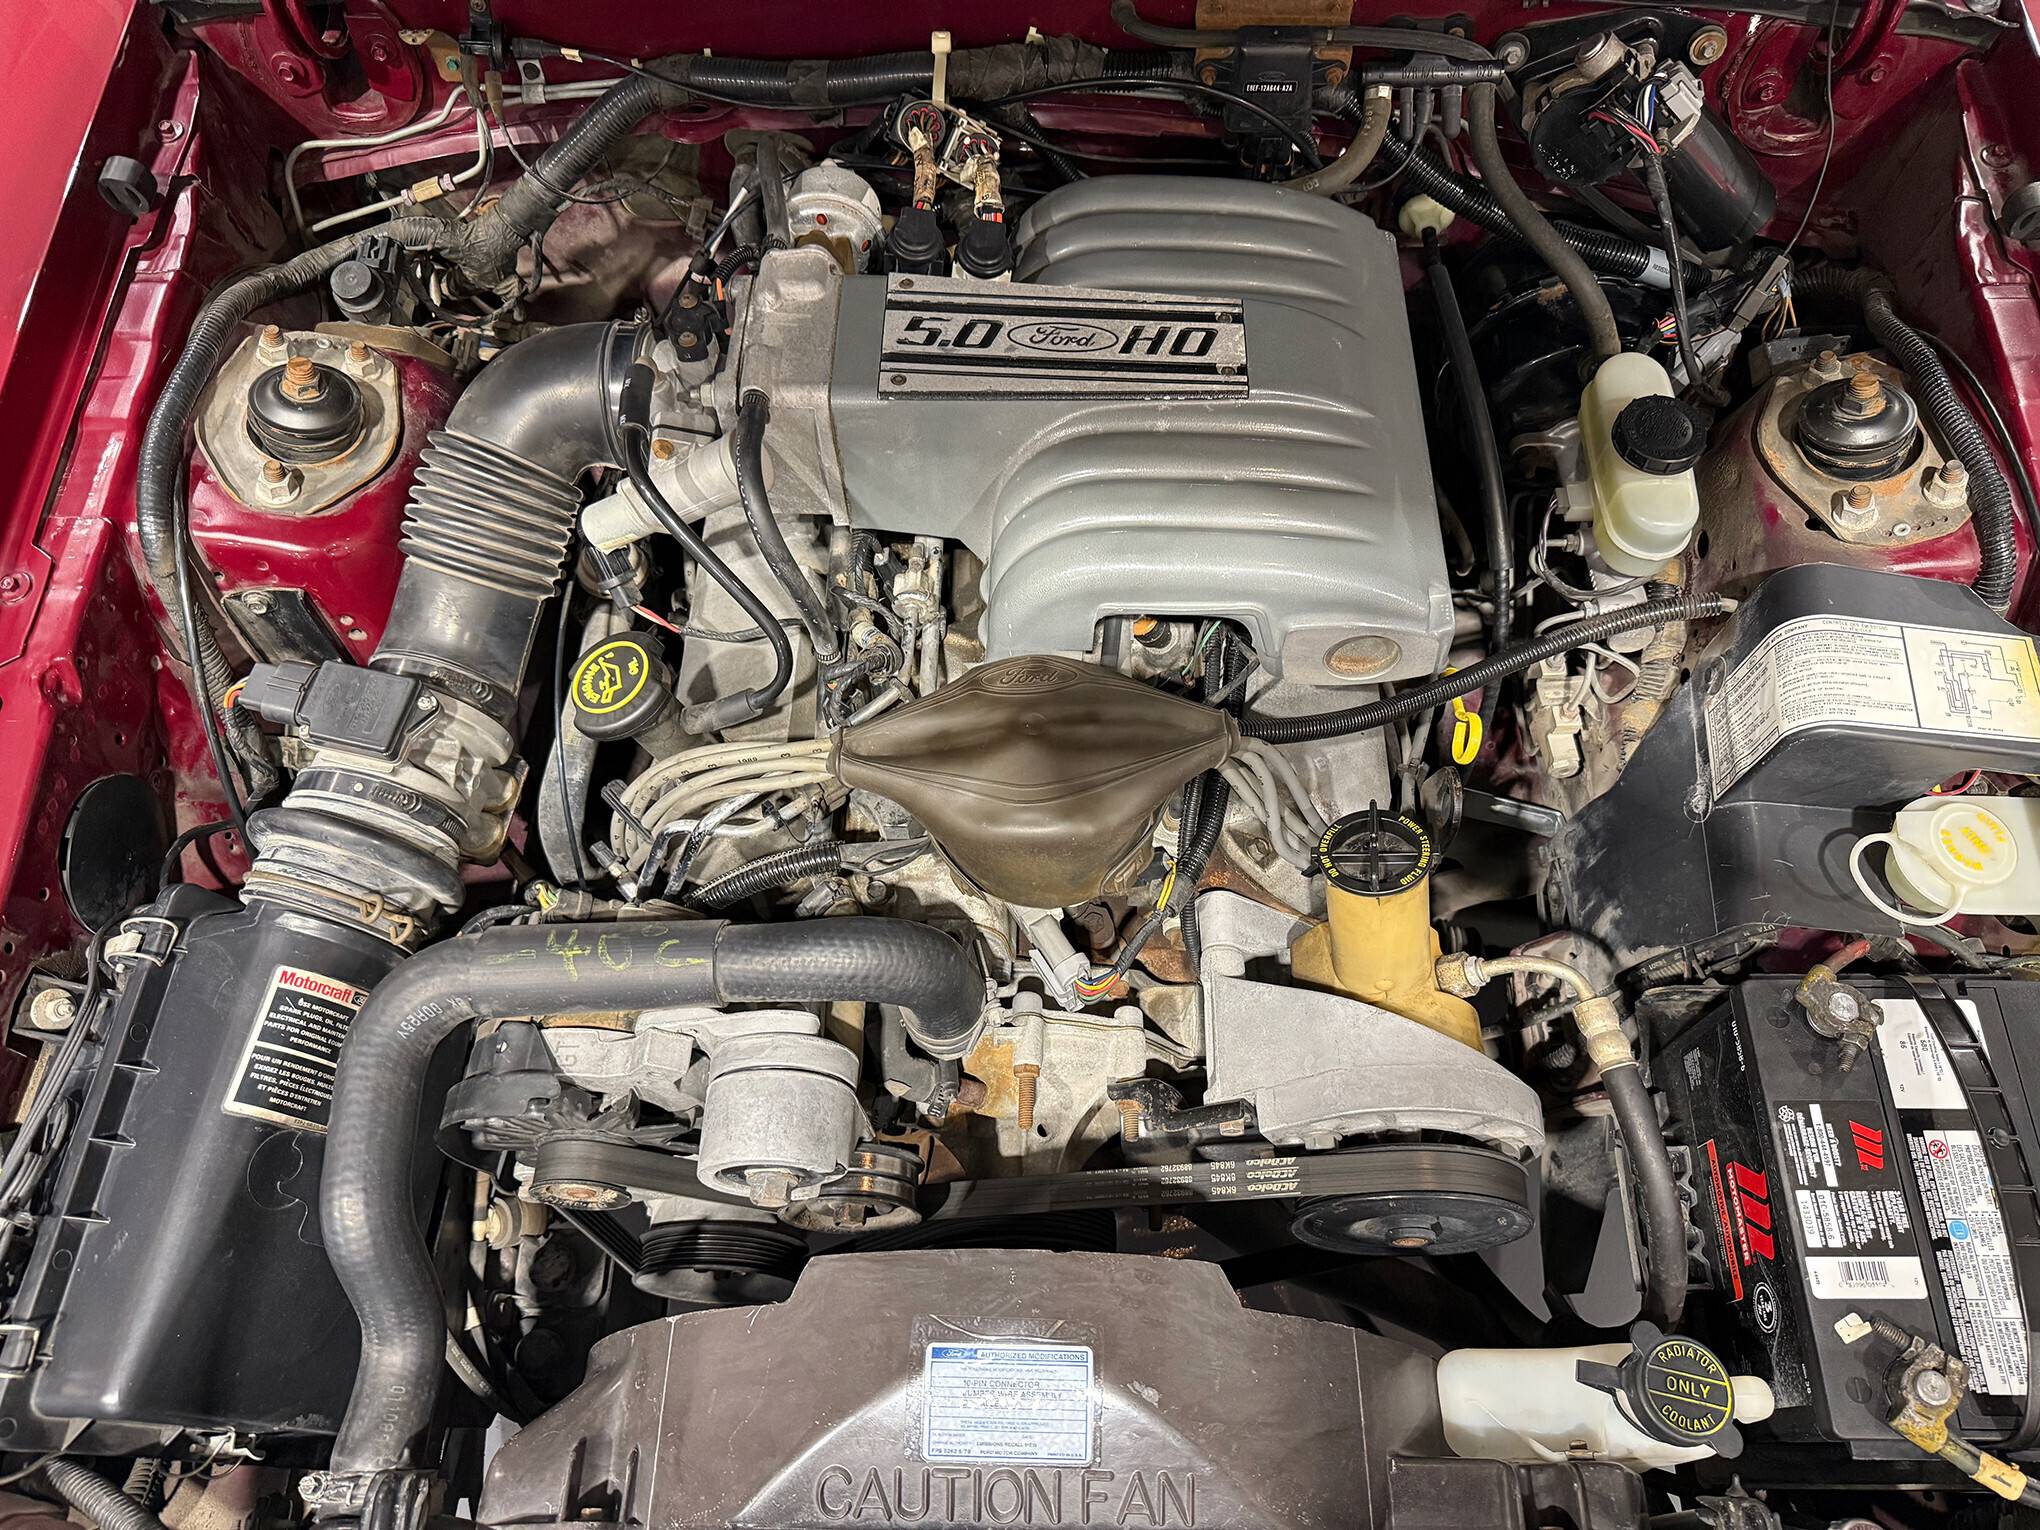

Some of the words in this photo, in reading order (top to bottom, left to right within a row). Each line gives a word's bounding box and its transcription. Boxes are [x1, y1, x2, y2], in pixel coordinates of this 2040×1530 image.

[896, 316, 1004, 348] 5.0
[1029, 325, 1096, 347] Ford
[1118, 324, 1219, 356] HO
[627, 656, 639, 676] OIL
[1000, 667, 1058, 685] Ford
[581, 662, 601, 704] ENGINE
[1398, 815, 1423, 835] POWER
[1319, 823, 1342, 852] OVERFILL
[1320, 854, 1332, 868] NOT
[1417, 835, 1431, 868] STEERING
[1328, 867, 1339, 878] DO
[1400, 867, 1422, 886] FLUID
[279, 970, 352, 1003] Motorcraft
[268, 1012, 307, 1027] ELECTRICAL
[308, 1022, 321, 1031] AND
[279, 1005, 302, 1016] SPARK
[312, 1004, 349, 1021] MOTORCRAFT
[263, 1020, 286, 1031] PARTS
[286, 1026, 300, 1035] FOR
[300, 1030, 327, 1044] ORIGINAL
[289, 1036, 332, 1054] PERFORMANCE
[1899, 1040, 1907, 1049] 86
[1919, 1039, 1928, 1052] 680
[251, 1052, 271, 1062] POUR
[271, 1056, 282, 1066] UN
[282, 1060, 318, 1076] RENDEMENT
[253, 1063, 278, 1074] EXIGEZ
[279, 1069, 291, 1077] LES
[257, 1083, 267, 1091] ET
[267, 1085, 289, 1097] PIÈCES
[289, 1092, 322, 1106] D'ENTRETIEN
[268, 1096, 308, 1112] MOTORCRAFT
[1825, 1123, 1835, 1137] NEED
[1830, 1144, 1841, 1167] BOOST?
[1210, 1160, 1236, 1169] 6K845
[1246, 1169, 1298, 1180] ACDelco
[1211, 1185, 1237, 1195] 6K845
[1247, 1181, 1299, 1193] ACDelco
[1945, 1160, 1953, 1170] KEEP
[1955, 1196, 1963, 1210] REACH
[1848, 1190, 1860, 1215] GRATUIT
[1855, 1215, 1863, 1224] DE
[1861, 1189, 1874, 1220] GARANTIE
[1869, 1219, 1877, 1229] DE
[1881, 1190, 1896, 1225] WARRANTY.
[1887, 1189, 1904, 1234] REPLACEMENT
[1947, 1196, 1955, 1207] HORS
[1727, 1167, 1750, 1260] MOTOMASTER
[1801, 1200, 1815, 1235] 1433039
[1855, 1190, 1873, 1240] REMPLACEMENT
[1900, 1212, 1909, 1229] FREE
[1966, 1242, 1974, 1253] READ
[1971, 1264, 1984, 1297] INSTRUCTIONS
[1986, 1320, 1994, 1332] OPEN
[980, 1351, 1027, 1359] AUTHORIZED
[1028, 1352, 1085, 1361] MODIFICATIONS
[1657, 1344, 1717, 1375] RADIATOR
[989, 1380, 1040, 1389] CONNECTOR
[1666, 1375, 1711, 1399] ONLY
[1661, 1404, 1716, 1431] COOLANT
[815, 1463, 1062, 1525] CAUTION
[1080, 1468, 1195, 1527] FAN
